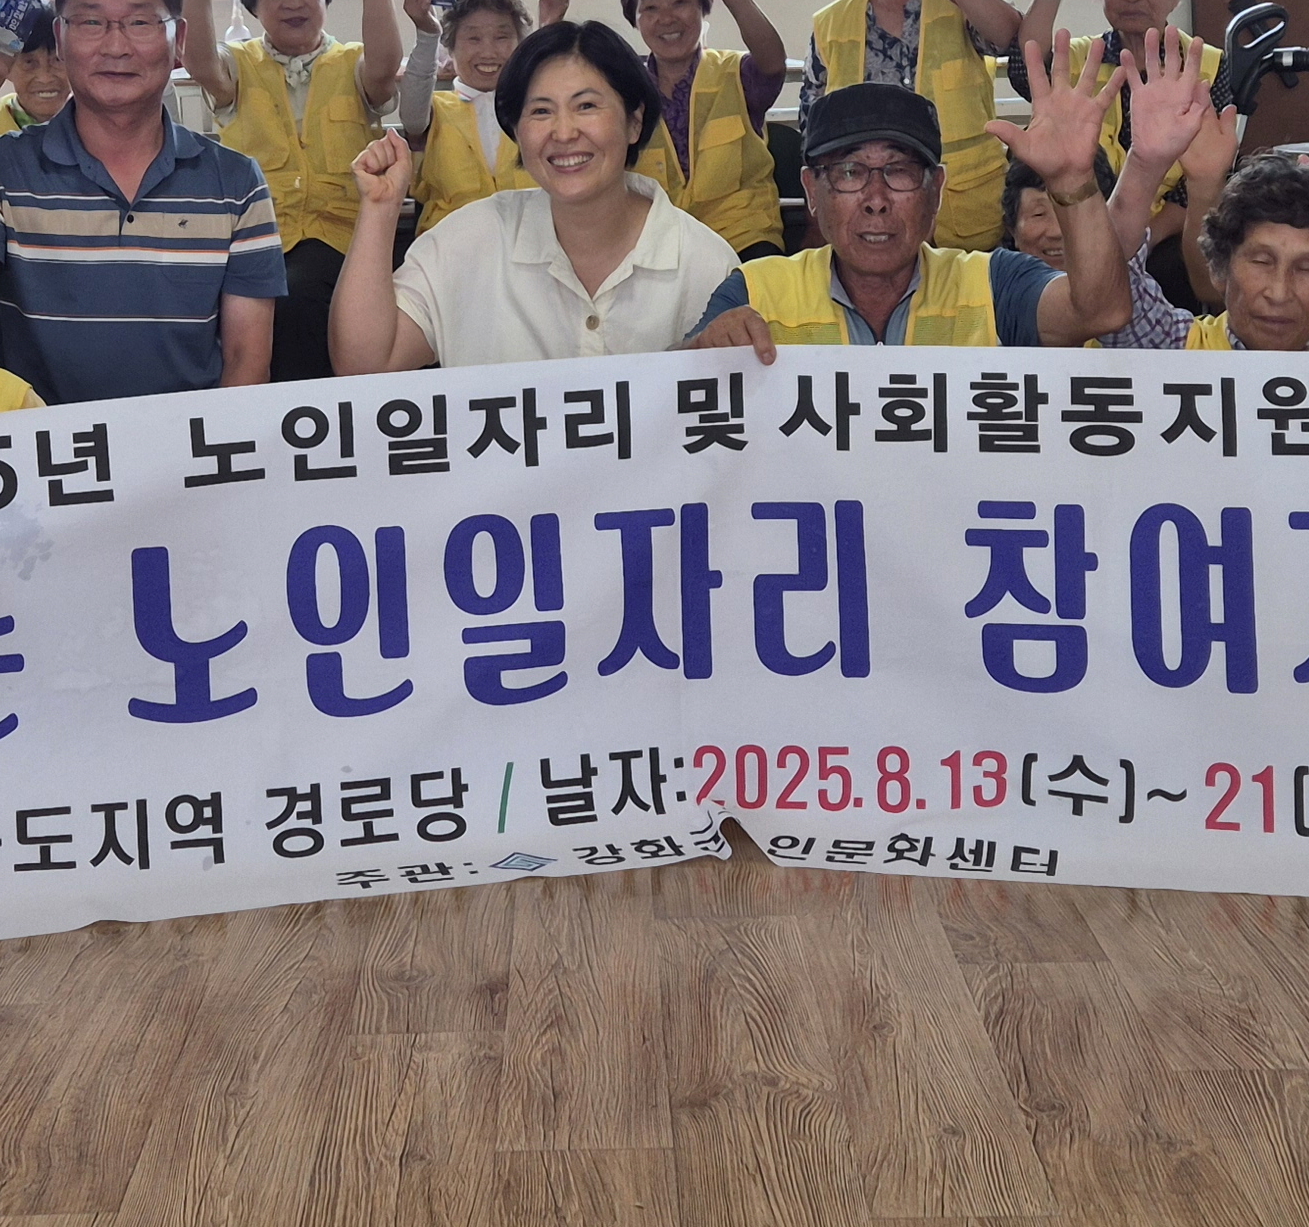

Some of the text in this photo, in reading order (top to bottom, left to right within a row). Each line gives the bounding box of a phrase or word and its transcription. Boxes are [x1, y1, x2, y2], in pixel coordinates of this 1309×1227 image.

[183, 380, 633, 489] 노인일자리
[677, 371, 750, 455] 및
[127, 499, 872, 724] 노인일자리
[264, 766, 470, 859] 경로당
